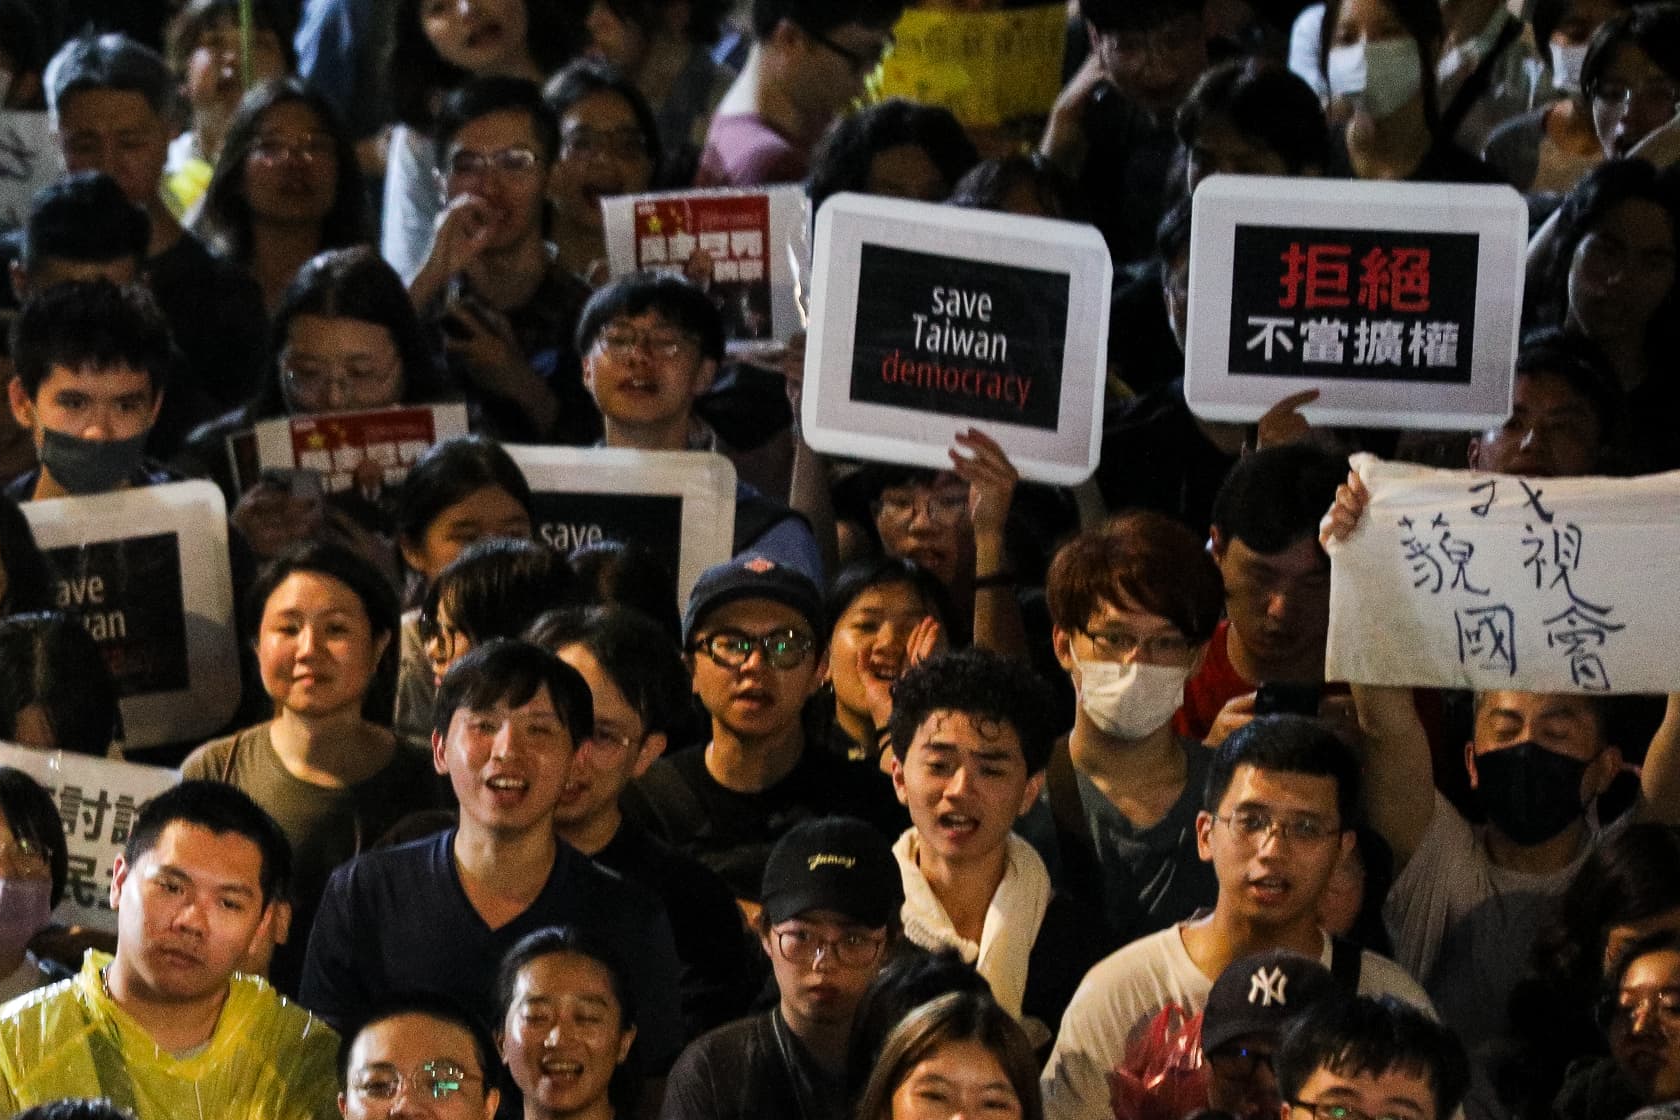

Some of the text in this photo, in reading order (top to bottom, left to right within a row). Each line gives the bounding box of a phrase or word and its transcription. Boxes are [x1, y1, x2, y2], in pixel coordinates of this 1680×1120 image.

[1278, 243, 1431, 312] 拒絕
[931, 284, 993, 323] save
[913, 313, 1009, 363] Taiwan
[1246, 315, 1460, 369] 不當擴權
[882, 350, 1032, 410] democracy
[540, 520, 604, 552] save
[55, 576, 105, 607] ave
[1454, 603, 1626, 691] 國會
[1247, 965, 1288, 1006] NY
